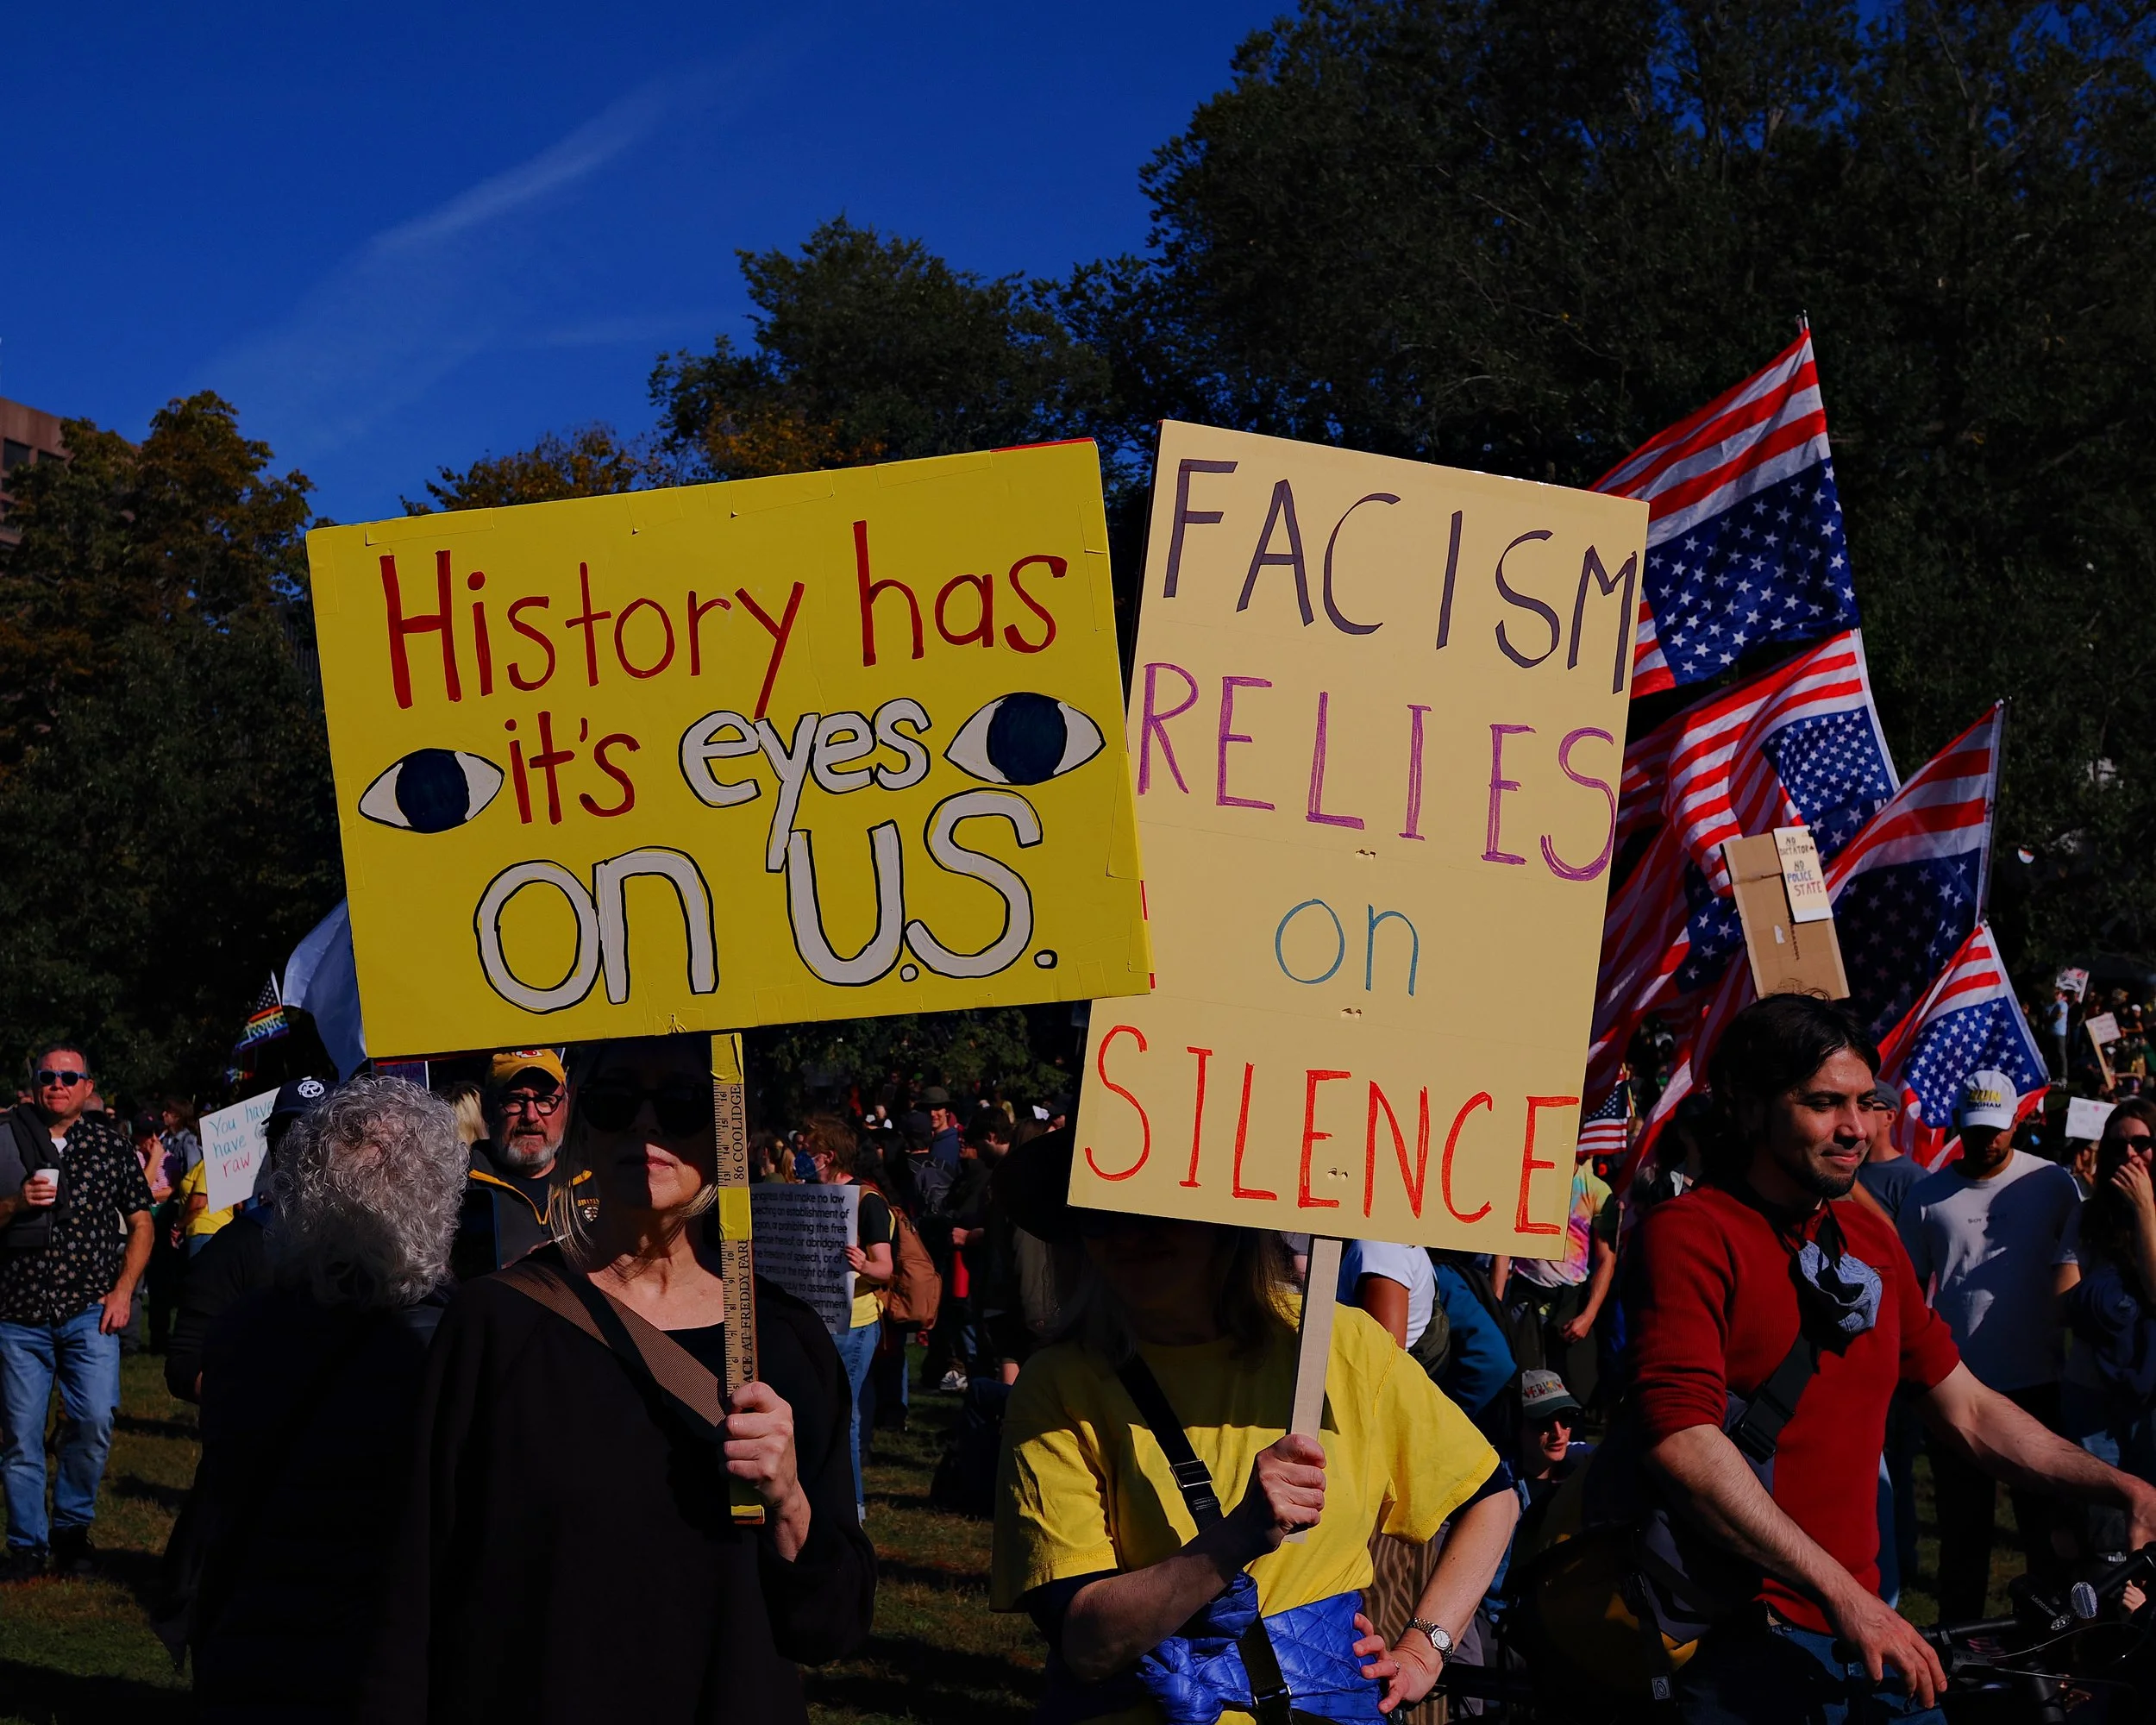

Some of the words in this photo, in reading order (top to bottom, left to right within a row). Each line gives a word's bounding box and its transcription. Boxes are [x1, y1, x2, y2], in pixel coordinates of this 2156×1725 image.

[1163, 459, 1638, 694] FACISM
[379, 549, 805, 719] History
[853, 520, 1068, 667] has
[1138, 662, 1616, 881] RELIES
[505, 711, 641, 825] it's
[678, 697, 932, 873] eyes
[1787, 870, 1813, 882] POLICE
[1794, 881, 1822, 896] STATE
[474, 846, 719, 1015] on
[786, 787, 1058, 987] U.S.
[1275, 899, 1419, 996] on
[209, 1118, 236, 1137] You
[730, 1086, 743, 1162] COOLIDGE
[1085, 1026, 1579, 1235] SILENCE
[213, 1135, 247, 1158] have
[222, 1152, 250, 1177] raw
[734, 1166, 744, 1179] 86
[795, 1193, 816, 1203] make
[818, 1195, 828, 1203] no
[830, 1193, 845, 1203] law
[787, 1208, 838, 1219] establishment
[840, 1209, 849, 1219] of
[816, 1222, 829, 1233] the
[831, 1223, 847, 1234] free
[806, 1238, 845, 1251] abridging
[833, 1254, 843, 1263] of
[798, 1266, 815, 1279] right
[808, 1283, 846, 1295] assemble,
[739, 1272, 750, 1328] FREDDY
[742, 1333, 752, 1352] AT
[743, 1356, 753, 1383] ACE
